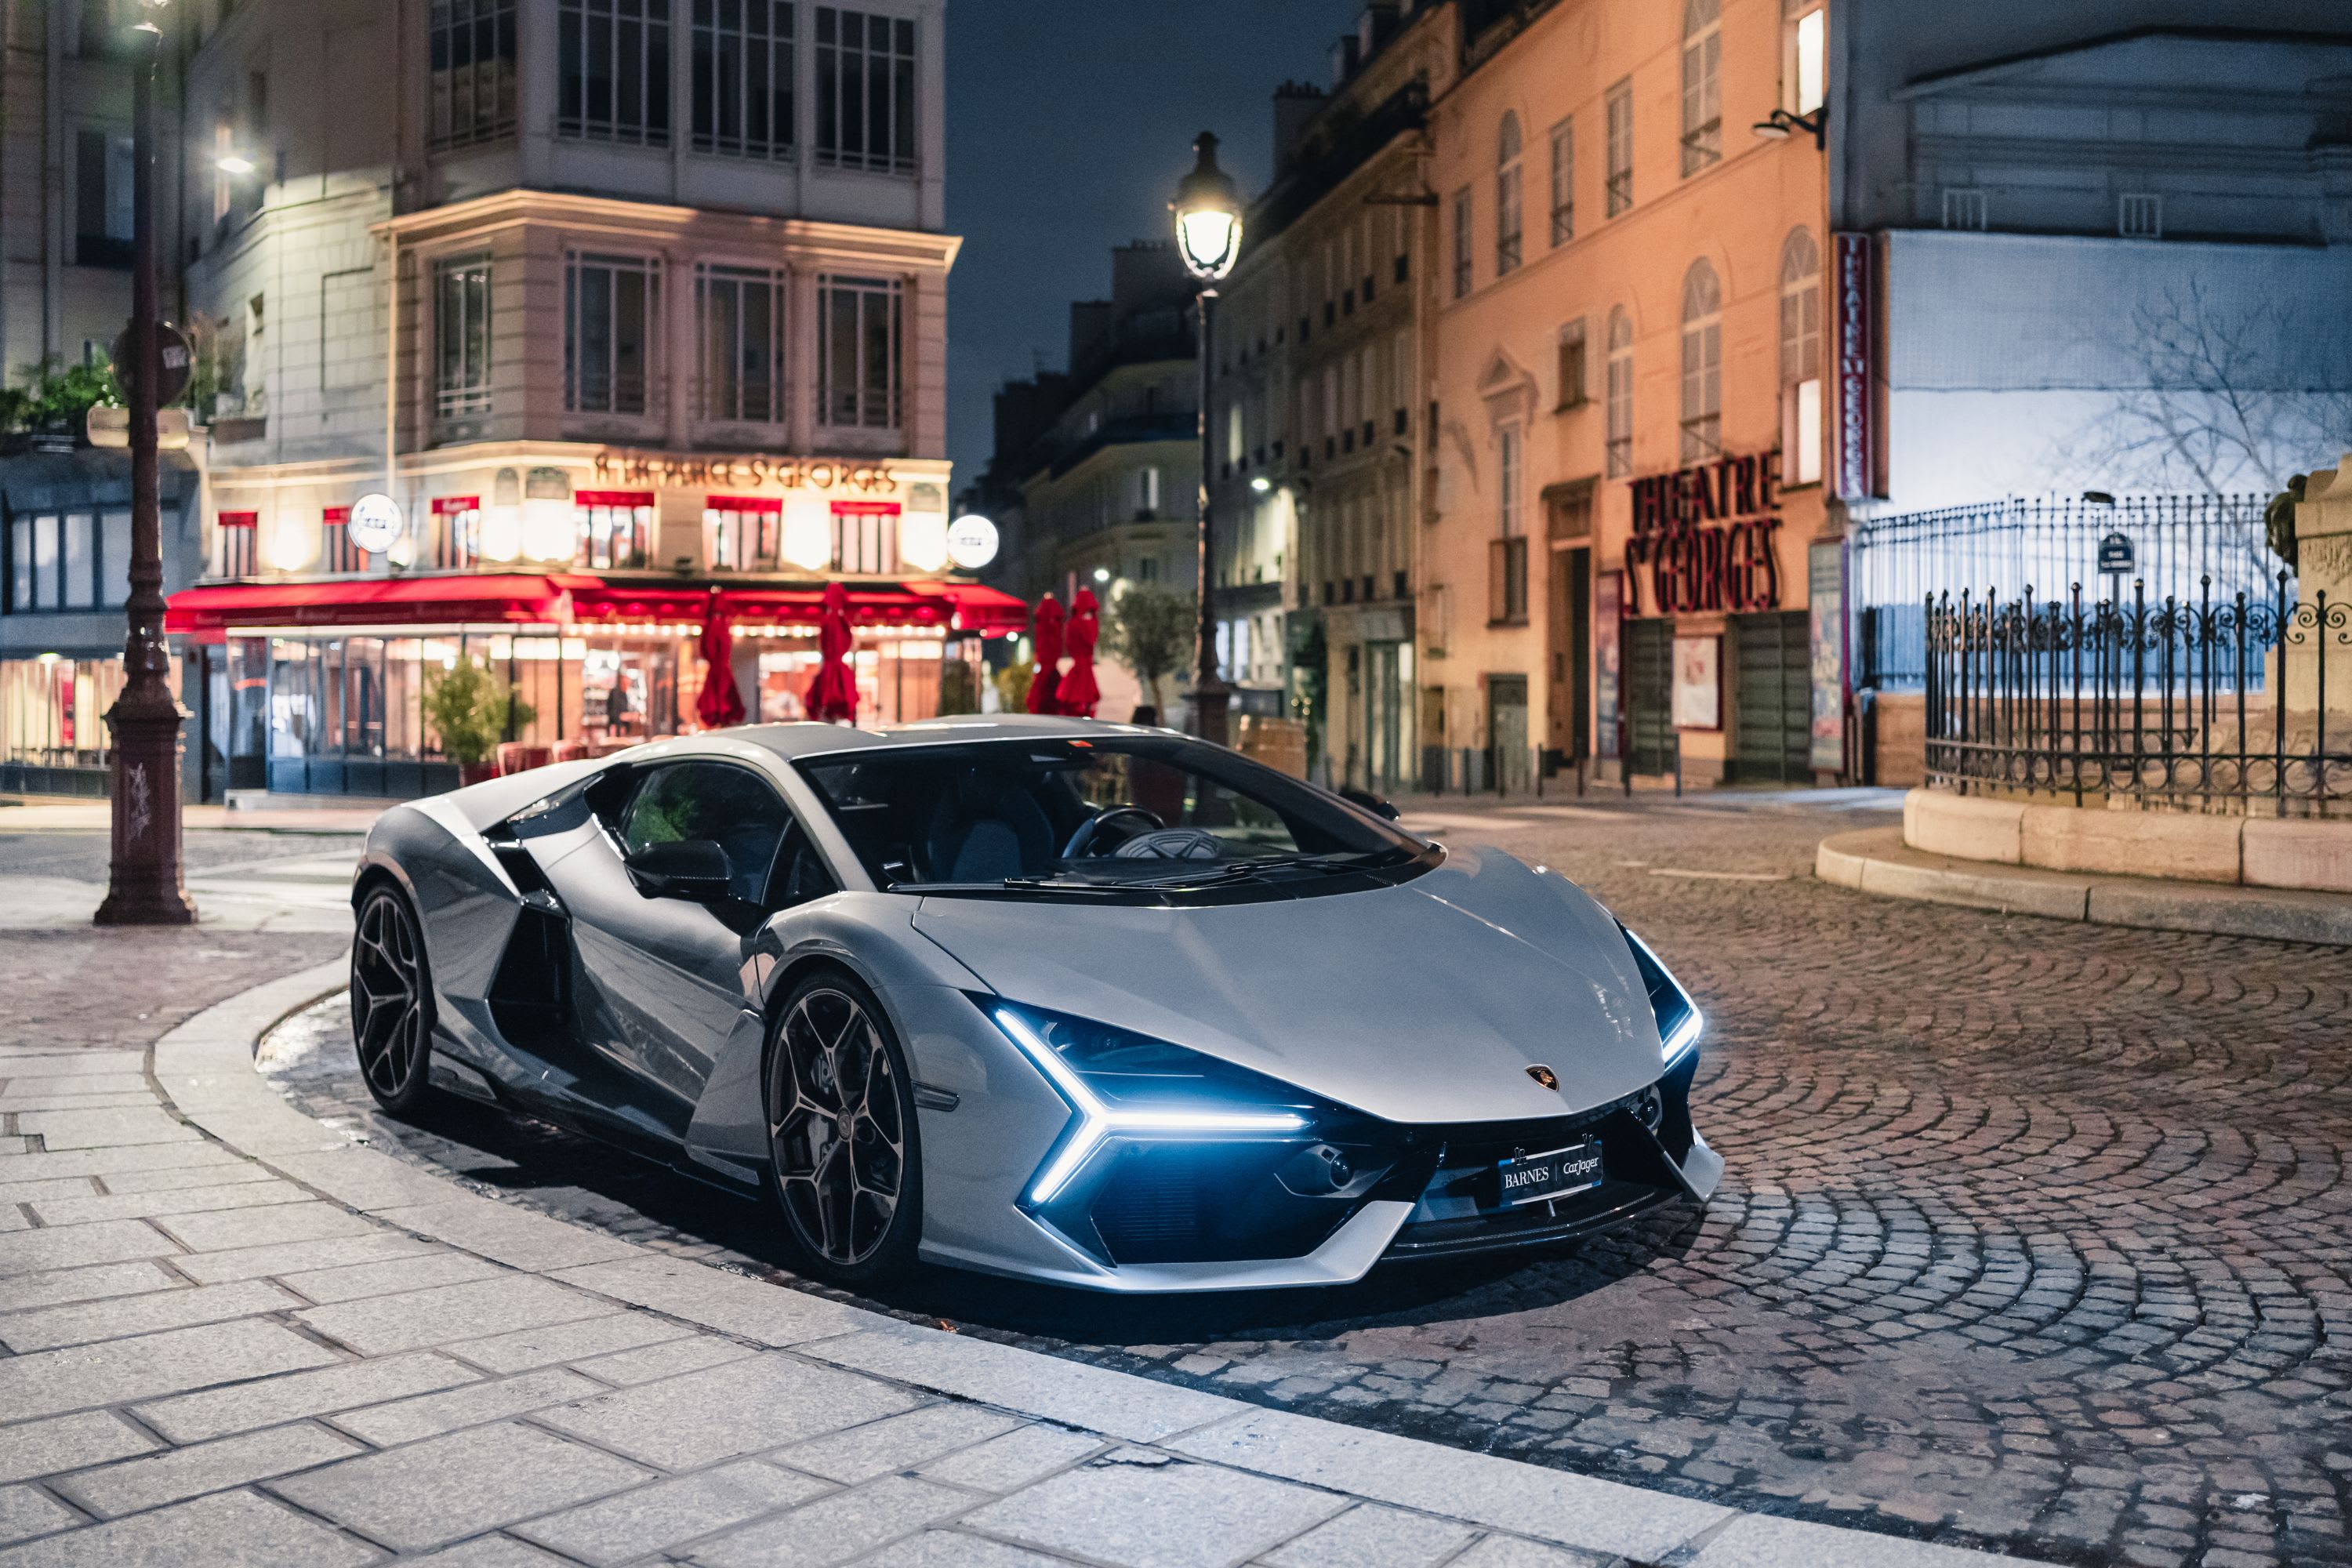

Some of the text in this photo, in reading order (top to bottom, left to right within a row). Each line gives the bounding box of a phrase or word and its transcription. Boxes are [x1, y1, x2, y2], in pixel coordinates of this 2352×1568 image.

[777, 461, 896, 492] GEORGES
[1627, 449, 1782, 535] THEATRE
[1653, 518, 1783, 613] GEORGES
[1504, 1167, 1549, 1189] BARNES
[1563, 1156, 1599, 1176] CarJager
